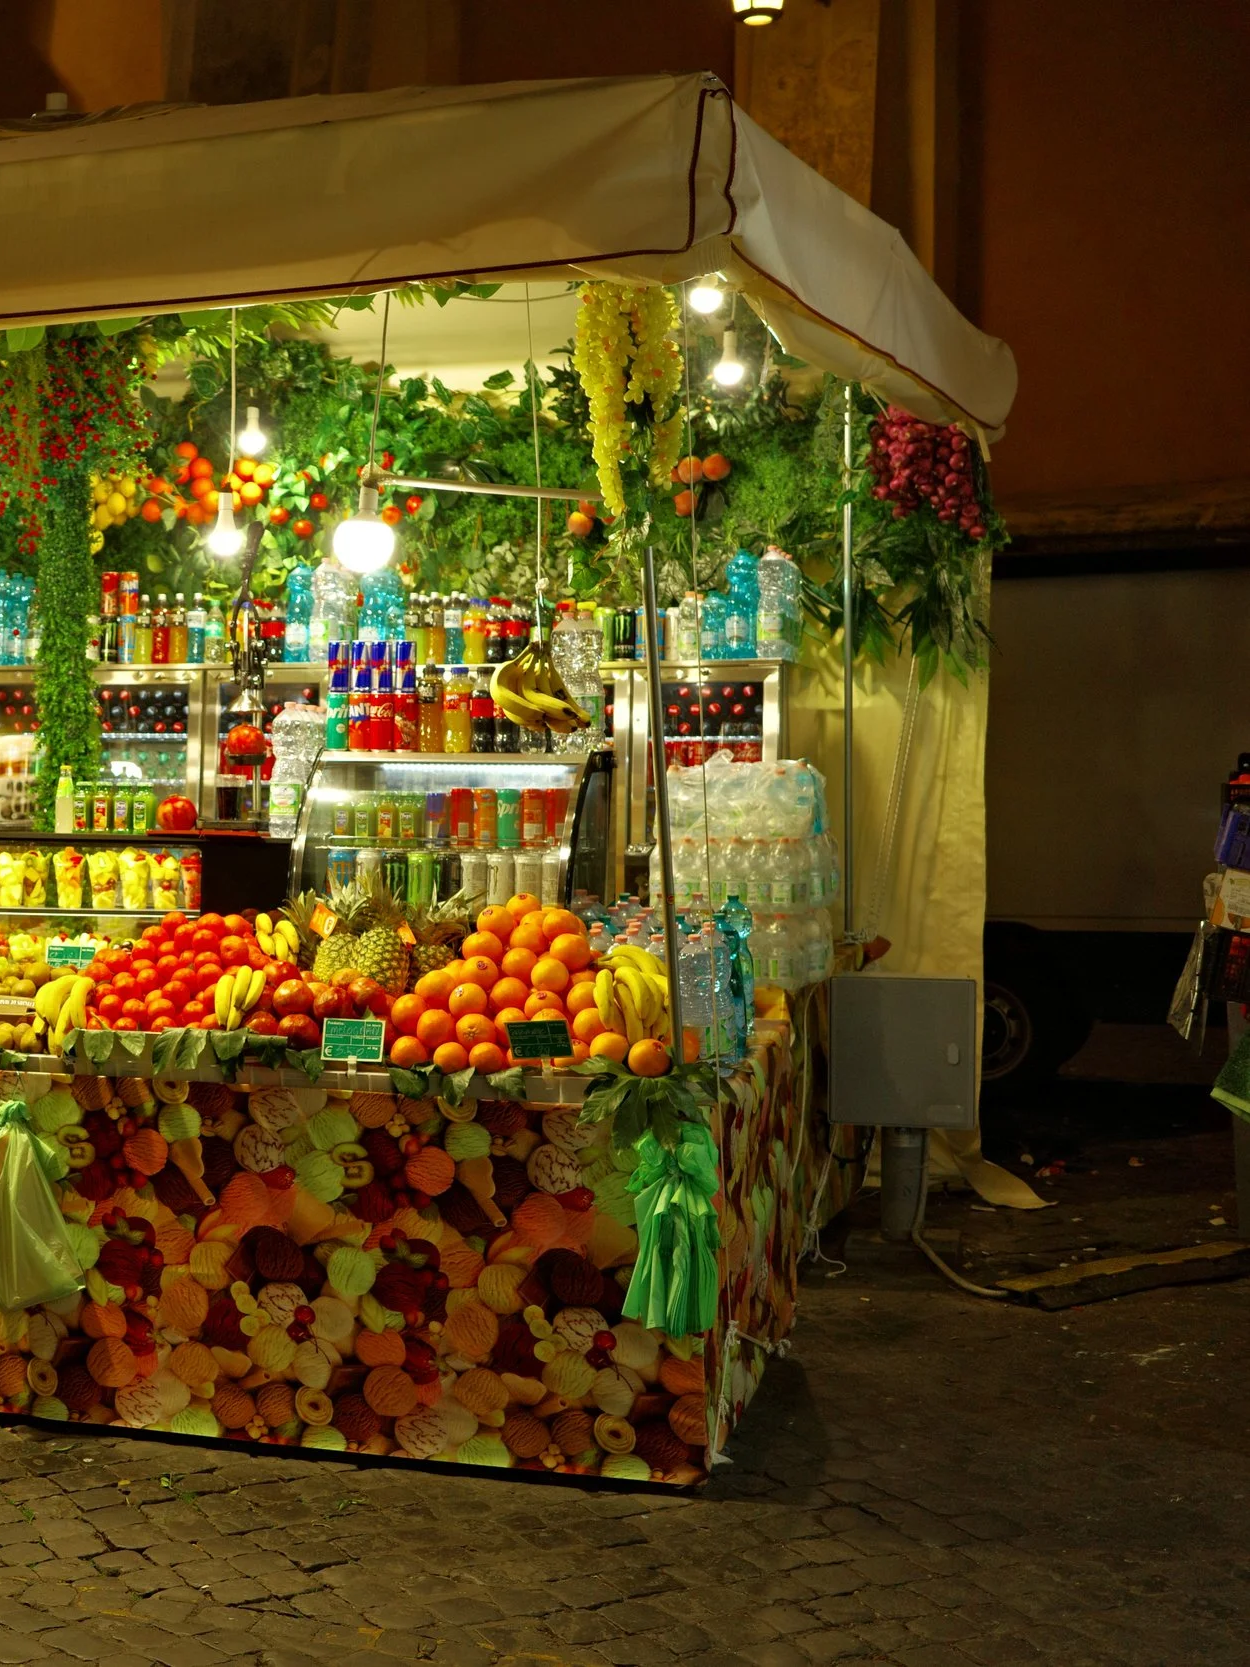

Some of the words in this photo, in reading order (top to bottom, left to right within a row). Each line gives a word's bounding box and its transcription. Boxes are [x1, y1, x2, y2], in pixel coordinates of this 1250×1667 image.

[327, 704, 348, 719] prit
[348, 703, 370, 717] ANT
[497, 799, 520, 818] Spri
[324, 1045, 333, 1056] €
[514, 1046, 523, 1057] €
